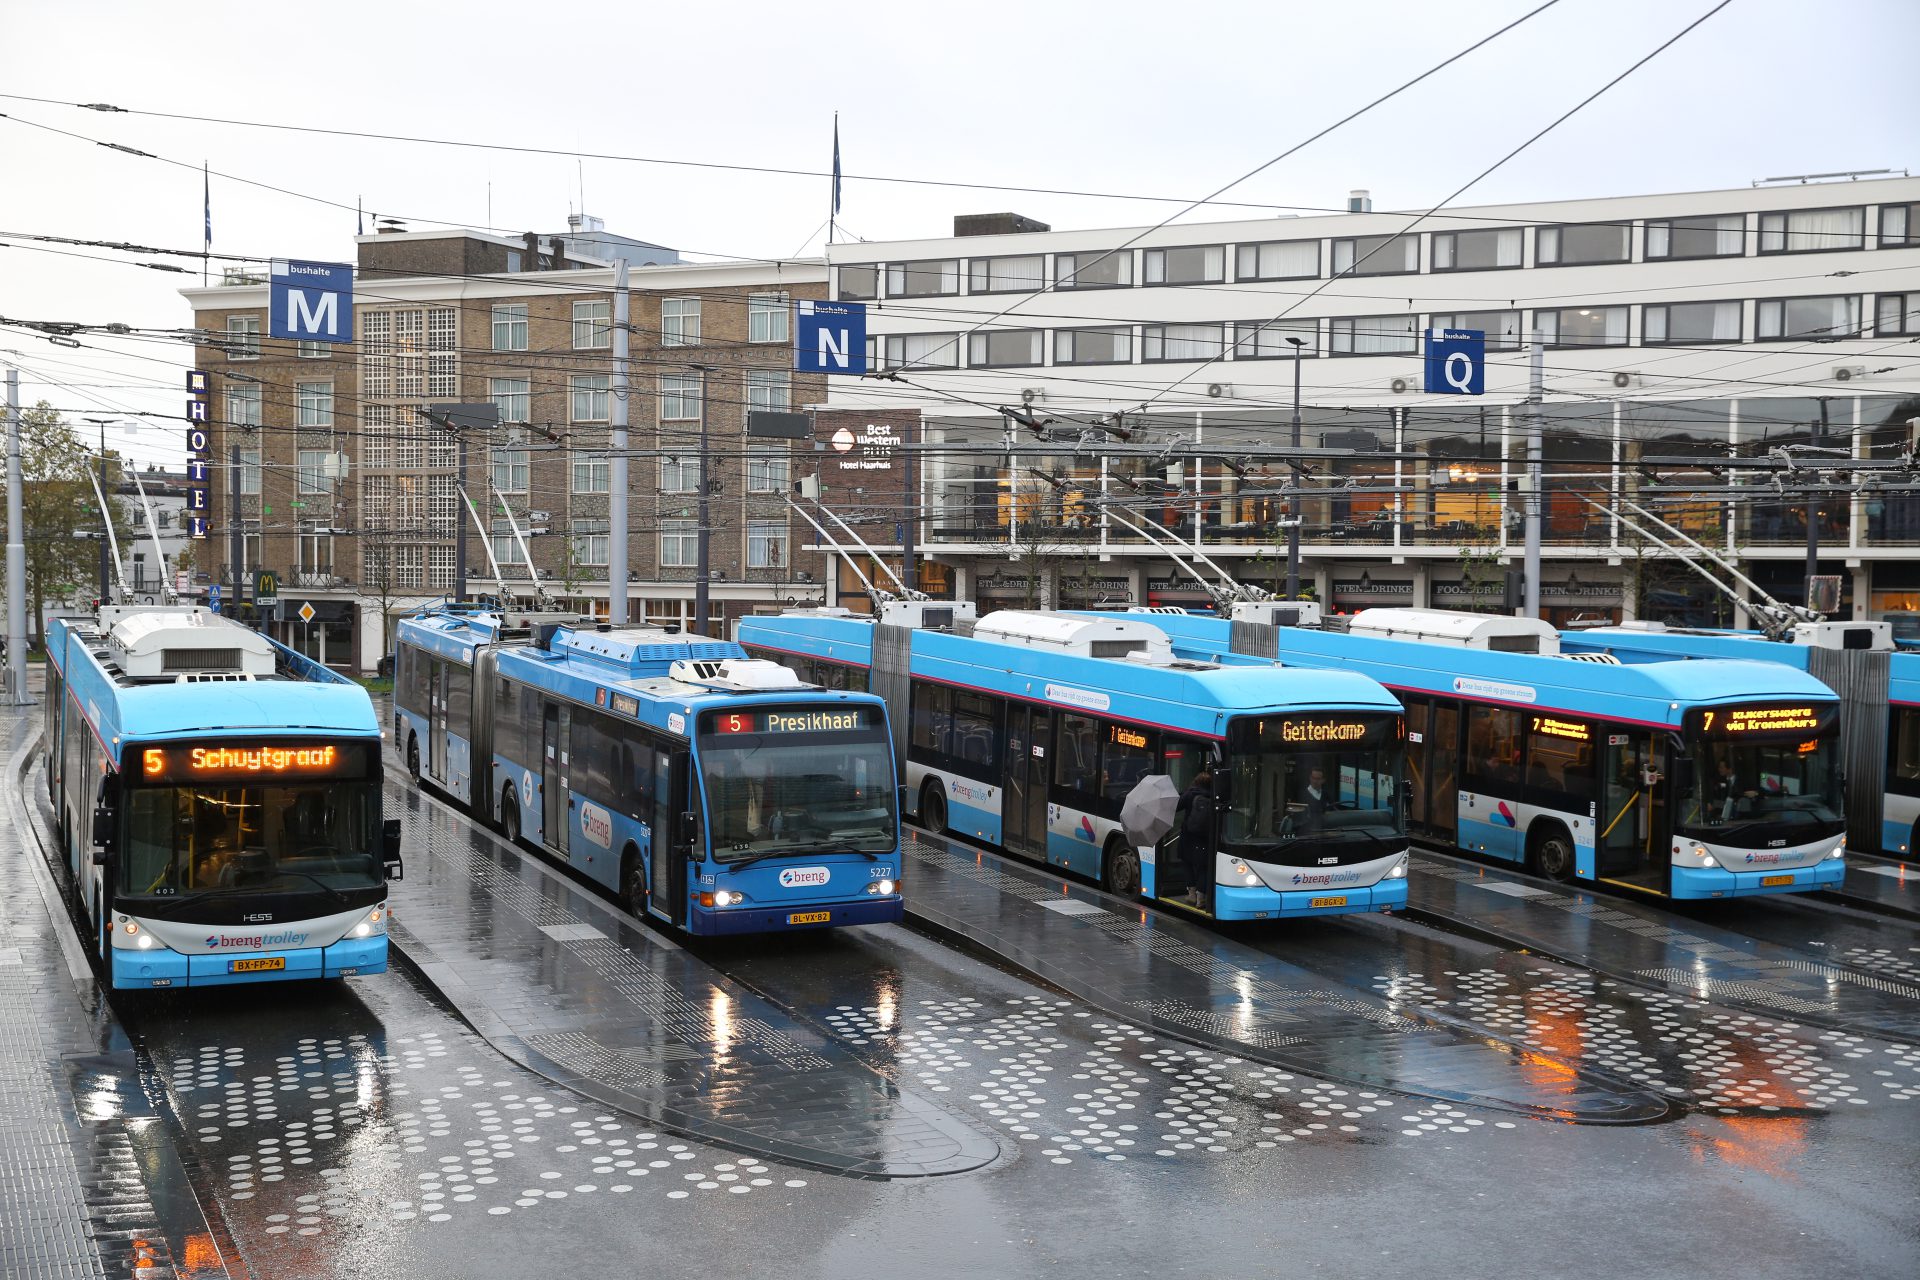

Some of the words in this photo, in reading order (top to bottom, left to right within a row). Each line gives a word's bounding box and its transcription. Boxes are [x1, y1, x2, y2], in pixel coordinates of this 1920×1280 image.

[291, 265, 331, 276] bushalte
[287, 289, 338, 335] M
[815, 305, 848, 315] bushalte
[1444, 332, 1471, 340] bushalte
[818, 327, 849, 368] N
[1444, 352, 1473, 394] Q
[867, 424, 891, 435] Best
[856, 435, 901, 446] Western
[863, 446, 891, 458] PLUS
[191, 402, 206, 536] HOTEL
[839, 461, 859, 470] Hotel
[860, 460, 891, 470] Haarhuis
[730, 714, 741, 732] 5
[768, 711, 858, 732] Presikhaaf
[1533, 717, 1540, 731] 7
[1703, 711, 1714, 731] 7
[1726, 720, 1745, 731] via
[1747, 718, 1817, 730] Kronenburg
[1282, 719, 1366, 742] Geitenkamp
[1541, 725, 1551, 734] via
[1117, 727, 1146, 748] Geitenkamp
[145, 748, 163, 773] 5
[191, 746, 335, 770] Schuytgraaf
[589, 808, 609, 847] breng
[1317, 856, 1339, 865] HESS
[794, 870, 825, 884] breng
[870, 867, 891, 878] 5227
[1301, 870, 1362, 885] brengtrolley
[1314, 898, 1345, 907] 81-BGX-2
[243, 913, 273, 922] HESS
[793, 913, 828, 923] BL-VX-82
[220, 930, 310, 948] brengtrolley
[237, 959, 281, 970] BX-FP-74
